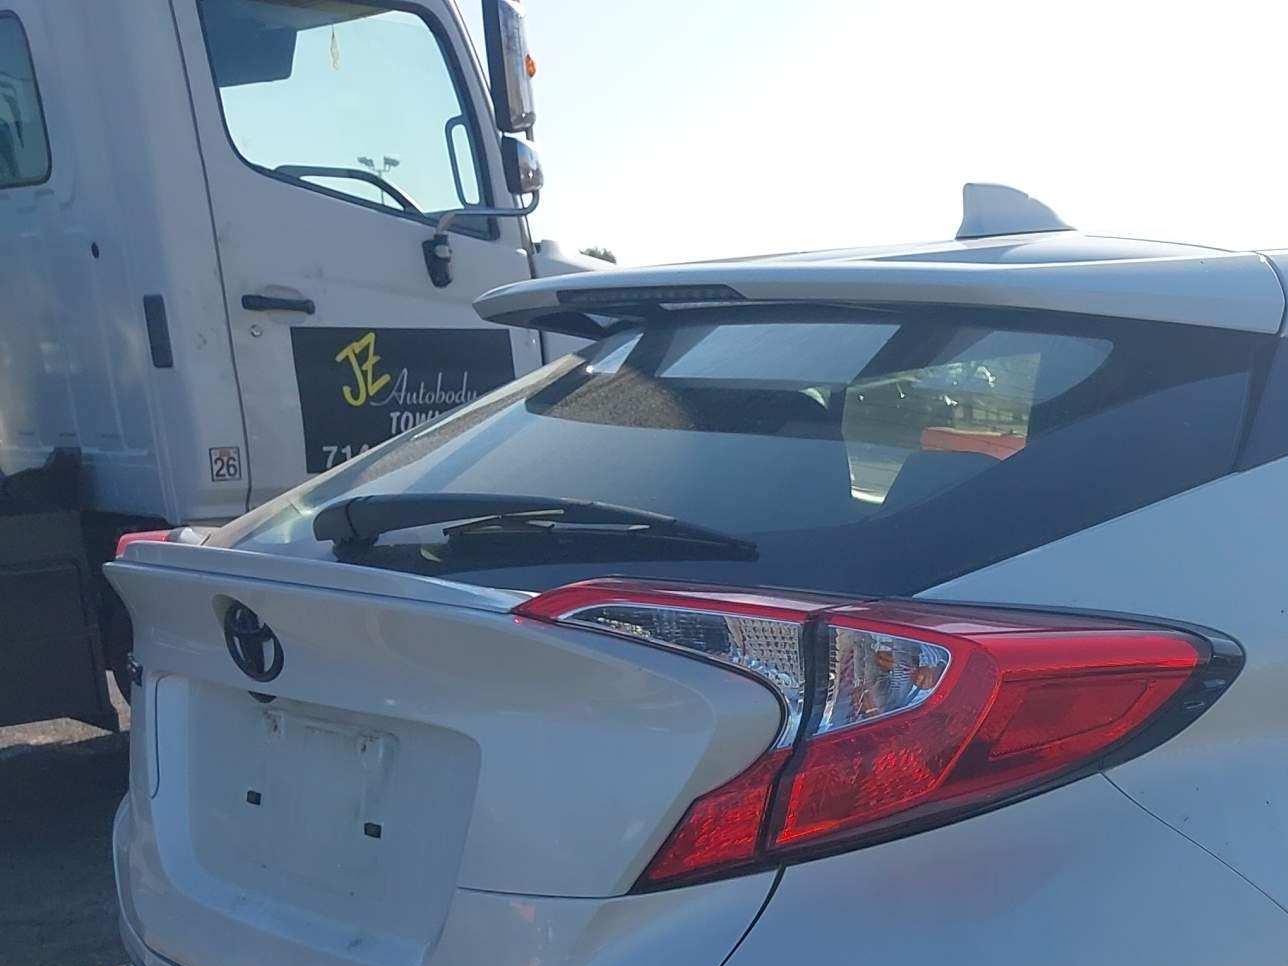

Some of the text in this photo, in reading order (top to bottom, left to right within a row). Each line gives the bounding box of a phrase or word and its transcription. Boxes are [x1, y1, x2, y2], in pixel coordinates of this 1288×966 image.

[335, 332, 391, 406] JZ
[390, 410, 440, 435] TOW
[214, 456, 238, 478] 26
